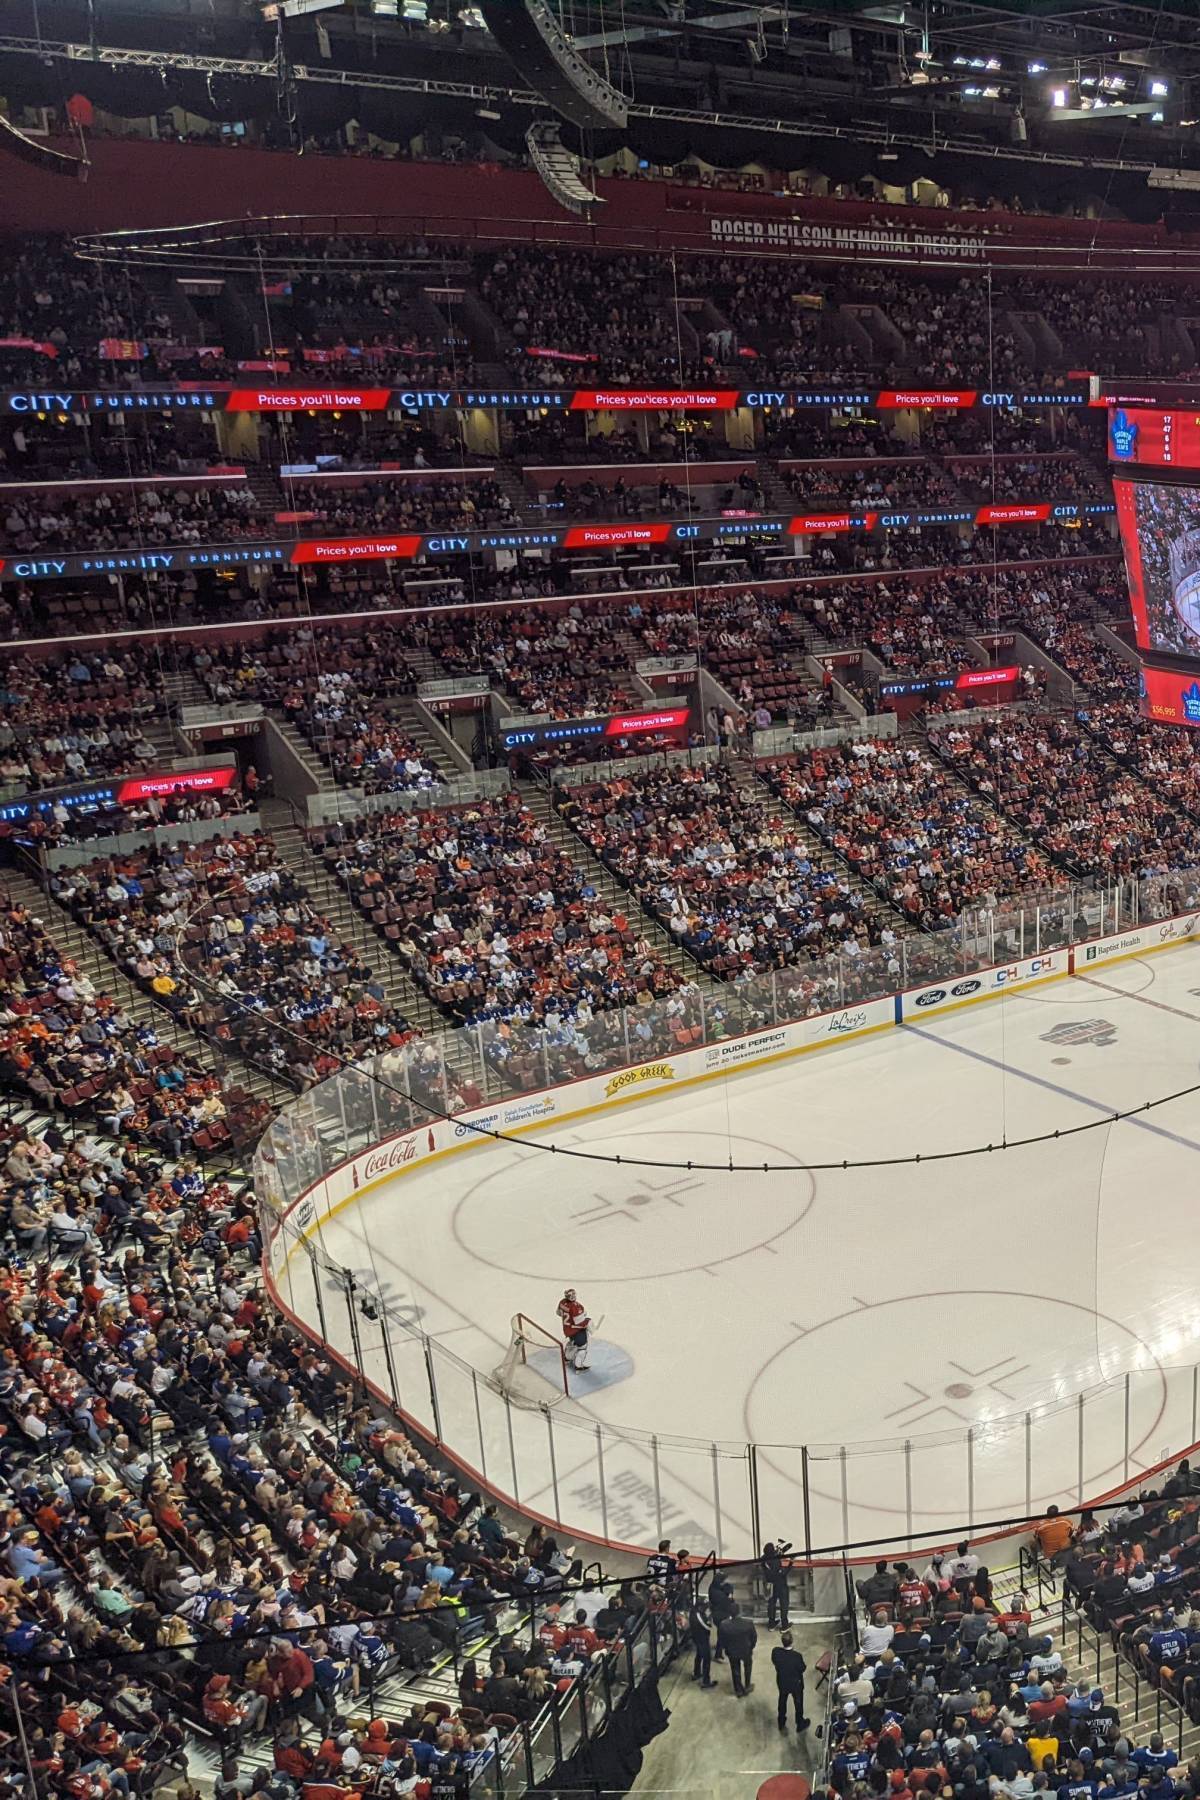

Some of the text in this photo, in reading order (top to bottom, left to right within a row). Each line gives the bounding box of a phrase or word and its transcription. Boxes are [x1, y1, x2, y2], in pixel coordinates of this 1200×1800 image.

[711, 219, 763, 244] ROGER
[767, 223, 832, 248] NEILSON
[836, 228, 911, 253] MEMORIAL
[10, 395, 214, 411] CITY FURNITURE
[258, 394, 361, 407] Prices you'll love
[401, 393, 561, 407] CITY FURNITURE
[596, 395, 626, 405] Prices
[696, 395, 717, 405] love
[747, 394, 870, 406] CITY FURNITURE
[895, 394, 959, 406] Prices you'll love
[982, 394, 1083, 405] CITY FURNITURE
[1163, 415, 1171, 424] 17
[1162, 425, 1171, 433] 47
[989, 511, 1006, 519] Prices
[1024, 509, 1037, 517] love
[1054, 506, 1078, 516] CITY
[805, 520, 827, 529] Prices
[881, 512, 972, 526] CITY FURNITURE
[720, 523, 782, 534] FURNITURE
[428, 535, 557, 551] CITY FURNITURE
[584, 530, 651, 542] Prices you'll love
[316, 543, 397, 557] Prices you'll love
[15, 560, 65, 577] CITY
[190, 550, 282, 563] FURNITURE
[1152, 705, 1176, 717] $56,995
[622, 715, 674, 729] Prices you'll love
[506, 726, 603, 745] CITY FURNITURE
[141, 776, 213, 793] Prices love
[1098, 935, 1141, 956] Baptist Health
[1031, 958, 1051, 972] CH
[997, 967, 1018, 982] CH
[954, 982, 982, 996] Ford
[919, 991, 943, 1005] Ford
[721, 1031, 786, 1055] DUDE PERFECT
[612, 1064, 667, 1089] GOOD GREEK
[533, 1104, 556, 1119] Hospital
